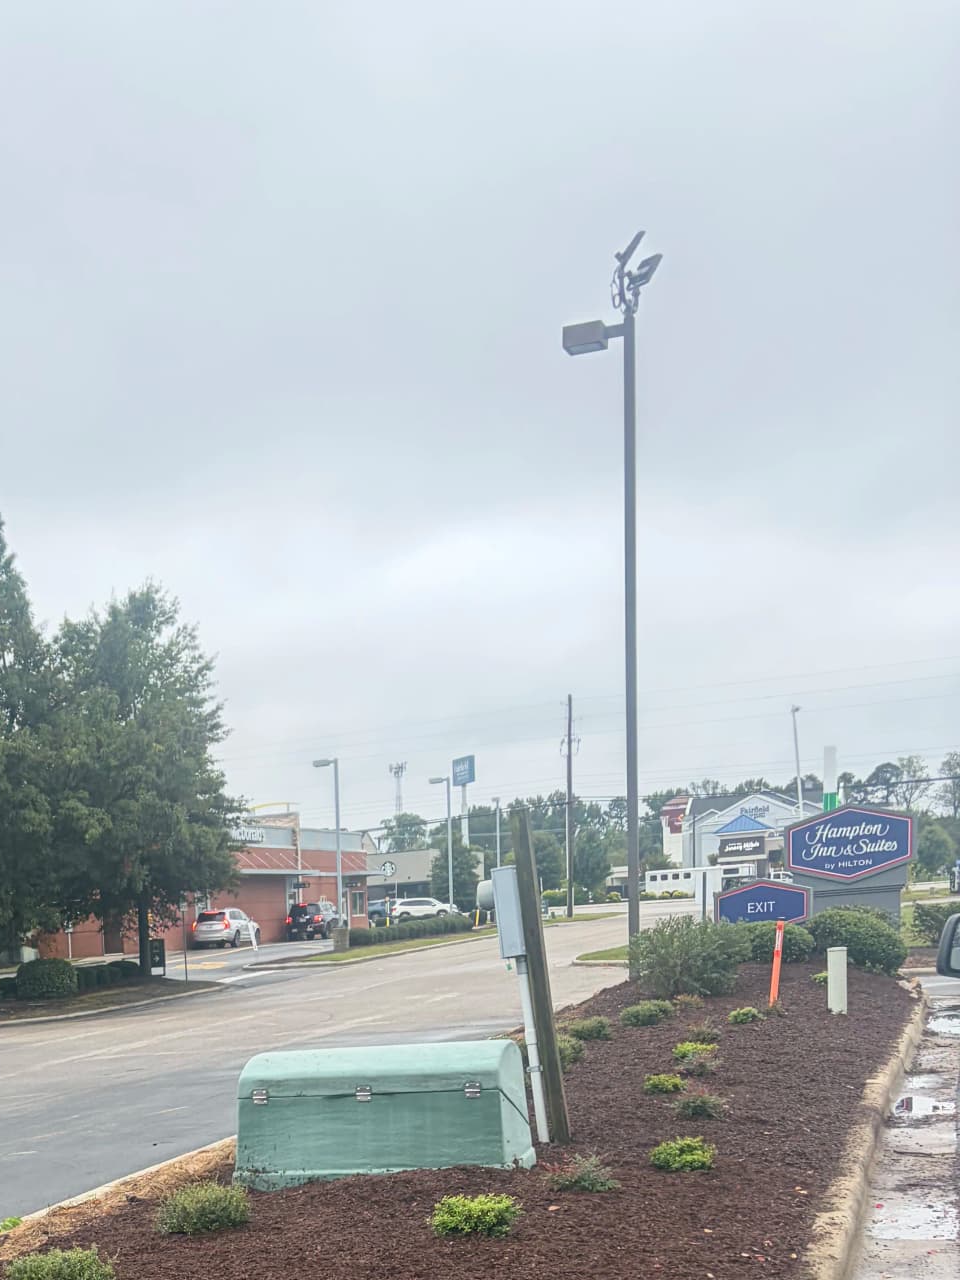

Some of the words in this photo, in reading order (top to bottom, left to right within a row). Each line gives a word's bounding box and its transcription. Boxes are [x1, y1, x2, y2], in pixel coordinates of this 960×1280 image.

[805, 821, 890, 845] Hampton
[802, 843, 844, 861] Inn
[843, 845, 855, 856] &
[852, 838, 898, 855] Suites
[824, 862, 836, 870] by
[838, 859, 873, 868] HILTON
[747, 901, 776, 913] EXIT
